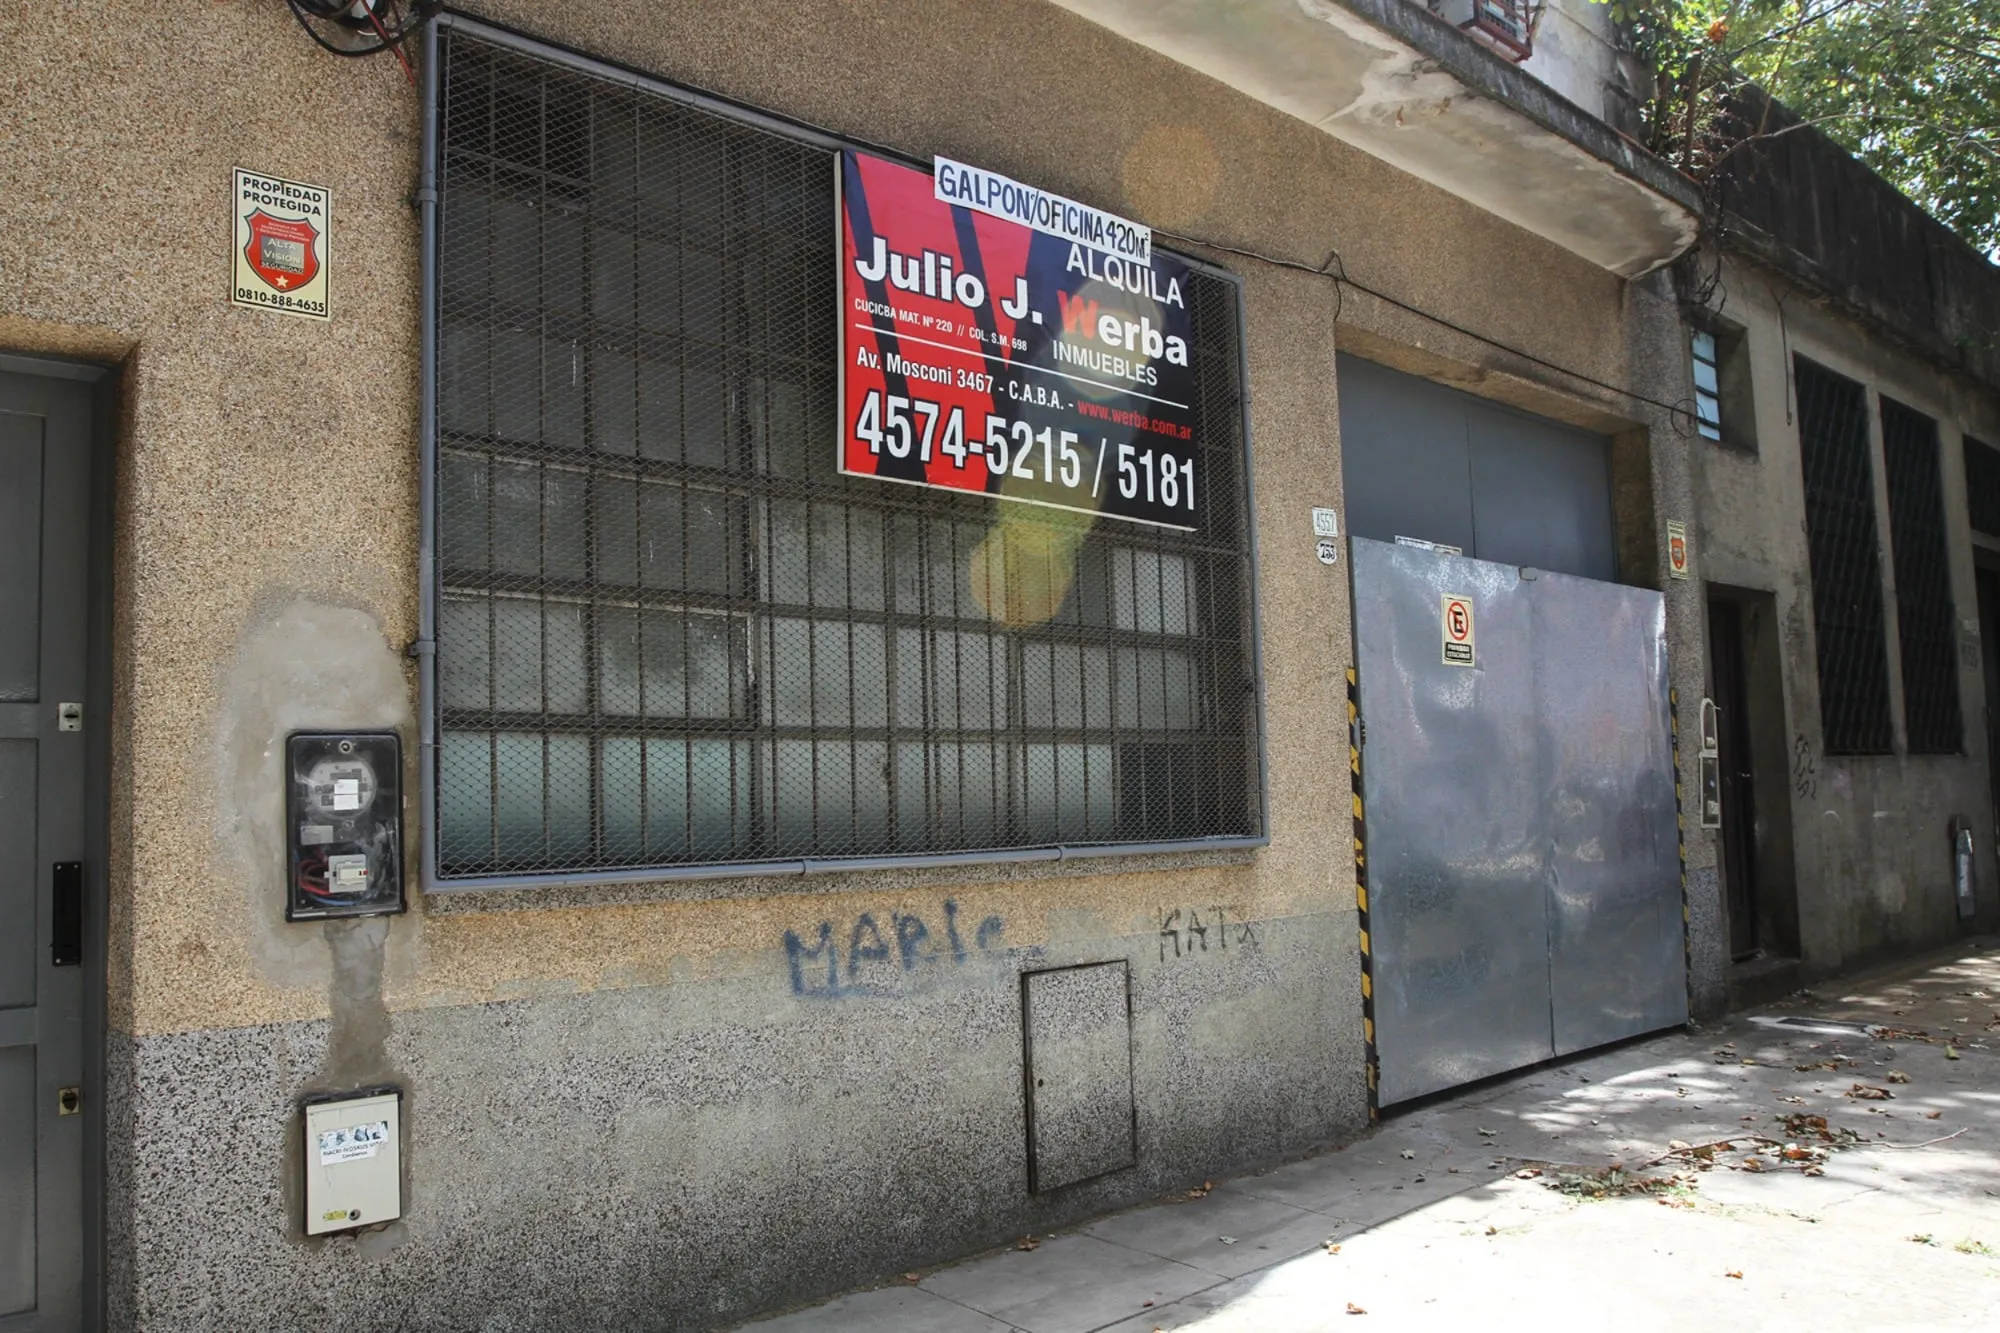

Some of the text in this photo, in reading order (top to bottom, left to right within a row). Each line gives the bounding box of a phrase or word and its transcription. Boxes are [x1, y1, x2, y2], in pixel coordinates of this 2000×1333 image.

[243, 176, 322, 203] PROPIEDAD
[243, 190, 322, 216] PROTEGIDA
[939, 164, 1030, 220] GALPON
[238, 288, 325, 312] 0810-888-4635
[854, 235, 1188, 367] Julio J. Werba
[1066, 243, 1184, 309] ALQUILA
[855, 298, 897, 319] CUCICBA
[899, 308, 921, 326] MAT.
[936, 319, 953, 333] 220
[969, 326, 989, 342] COL.
[991, 333, 1010, 347] S.M.
[1012, 338, 1028, 351] 698
[1053, 340, 1158, 386] INMUEBLES
[857, 346, 881, 370] Av.
[886, 352, 952, 385] Mosconi
[957, 368, 994, 393] 3467
[1008, 380, 1065, 410] C.A.B.A.
[1077, 399, 1192, 440] www.werba.com.ar
[856, 391, 1081, 488] 4574-5215
[1118, 443, 1194, 511] 5181
